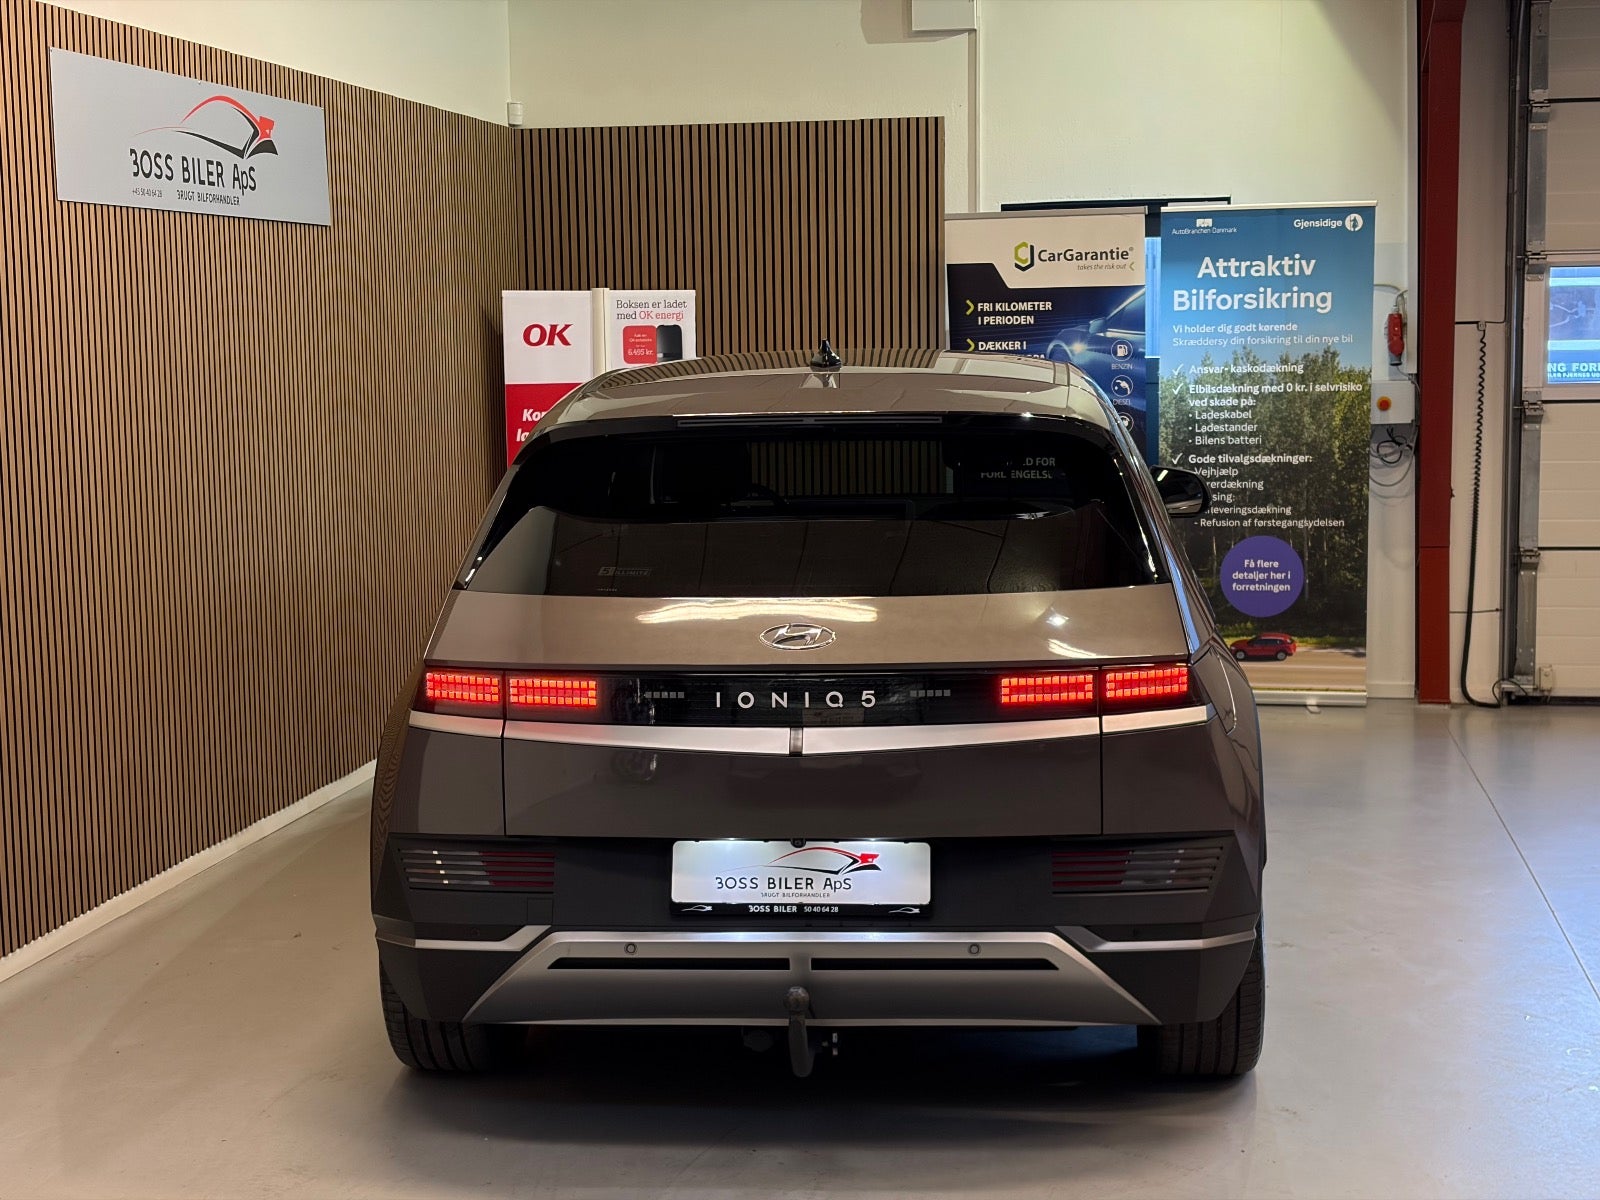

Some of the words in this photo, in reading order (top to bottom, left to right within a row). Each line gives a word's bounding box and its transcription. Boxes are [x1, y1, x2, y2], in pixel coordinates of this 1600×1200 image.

[181, 155, 225, 188] BILER
[232, 163, 257, 196] ApS
[1294, 219, 1342, 229] Gjensidige
[1197, 254, 1317, 279] Attraktiv
[616, 300, 650, 309] Boksen
[664, 300, 687, 309] ladet
[1173, 287, 1332, 314] Bilforsikring
[978, 303, 993, 312] FRI
[995, 302, 1052, 311] KILOMETER
[617, 312, 637, 320] med
[639, 311, 654, 319] OK
[656, 312, 684, 321] energi
[983, 316, 1034, 325] PERIODEN
[1173, 325, 1183, 333] Vi
[1184, 324, 1216, 333] holder
[1217, 324, 1233, 335] dig
[1234, 323, 1257, 335] godt
[1258, 323, 1298, 332] kørende
[522, 323, 573, 346] OK
[978, 341, 1020, 350] DÆKKER
[1172, 336, 1228, 347] Skræddersy
[1230, 336, 1245, 345] din
[1247, 335, 1292, 346] forsikring
[1293, 335, 1303, 343] til
[1305, 335, 1320, 343] din
[1341, 334, 1353, 343] bil
[1189, 365, 1228, 374] Ansvar-
[1230, 364, 1304, 374] kaskodækning
[1572, 363, 1600, 372] FOR
[1189, 383, 1260, 394] Elbilsdækning
[1261, 384, 1285, 392] med
[1286, 383, 1293, 392] 0
[1295, 383, 1308, 392] kr.
[1315, 382, 1363, 391] selvrisiko
[1189, 398, 1208, 406] ved
[1209, 397, 1239, 406] skade
[1240, 397, 1256, 408] på:
[1195, 410, 1252, 419] Ladeskabel
[1195, 423, 1258, 433] Ladestander
[1195, 436, 1226, 445] Bilens
[1227, 435, 1262, 444] batteri
[1035, 458, 1055, 467] FOR
[1188, 455, 1216, 464] Gode
[1218, 454, 1312, 465] tilvalgsdækninger:
[1194, 467, 1239, 478] Vejhjælp
[1206, 480, 1264, 491] rerdækning
[1200, 518, 1241, 527] Refusion
[1242, 517, 1252, 526] af
[1253, 516, 1345, 529] førstegangsydelsen
[1244, 559, 1255, 567] Få
[1257, 559, 1279, 567] flere
[1232, 571, 1268, 581] detaljer
[1270, 571, 1285, 579] her
[1232, 583, 1291, 593] forretningen
[716, 691, 844, 708] IONIQ
[861, 691, 876, 708] 5
[767, 877, 814, 889] BILER
[823, 877, 852, 892] ApS
[773, 905, 797, 913] BILER
